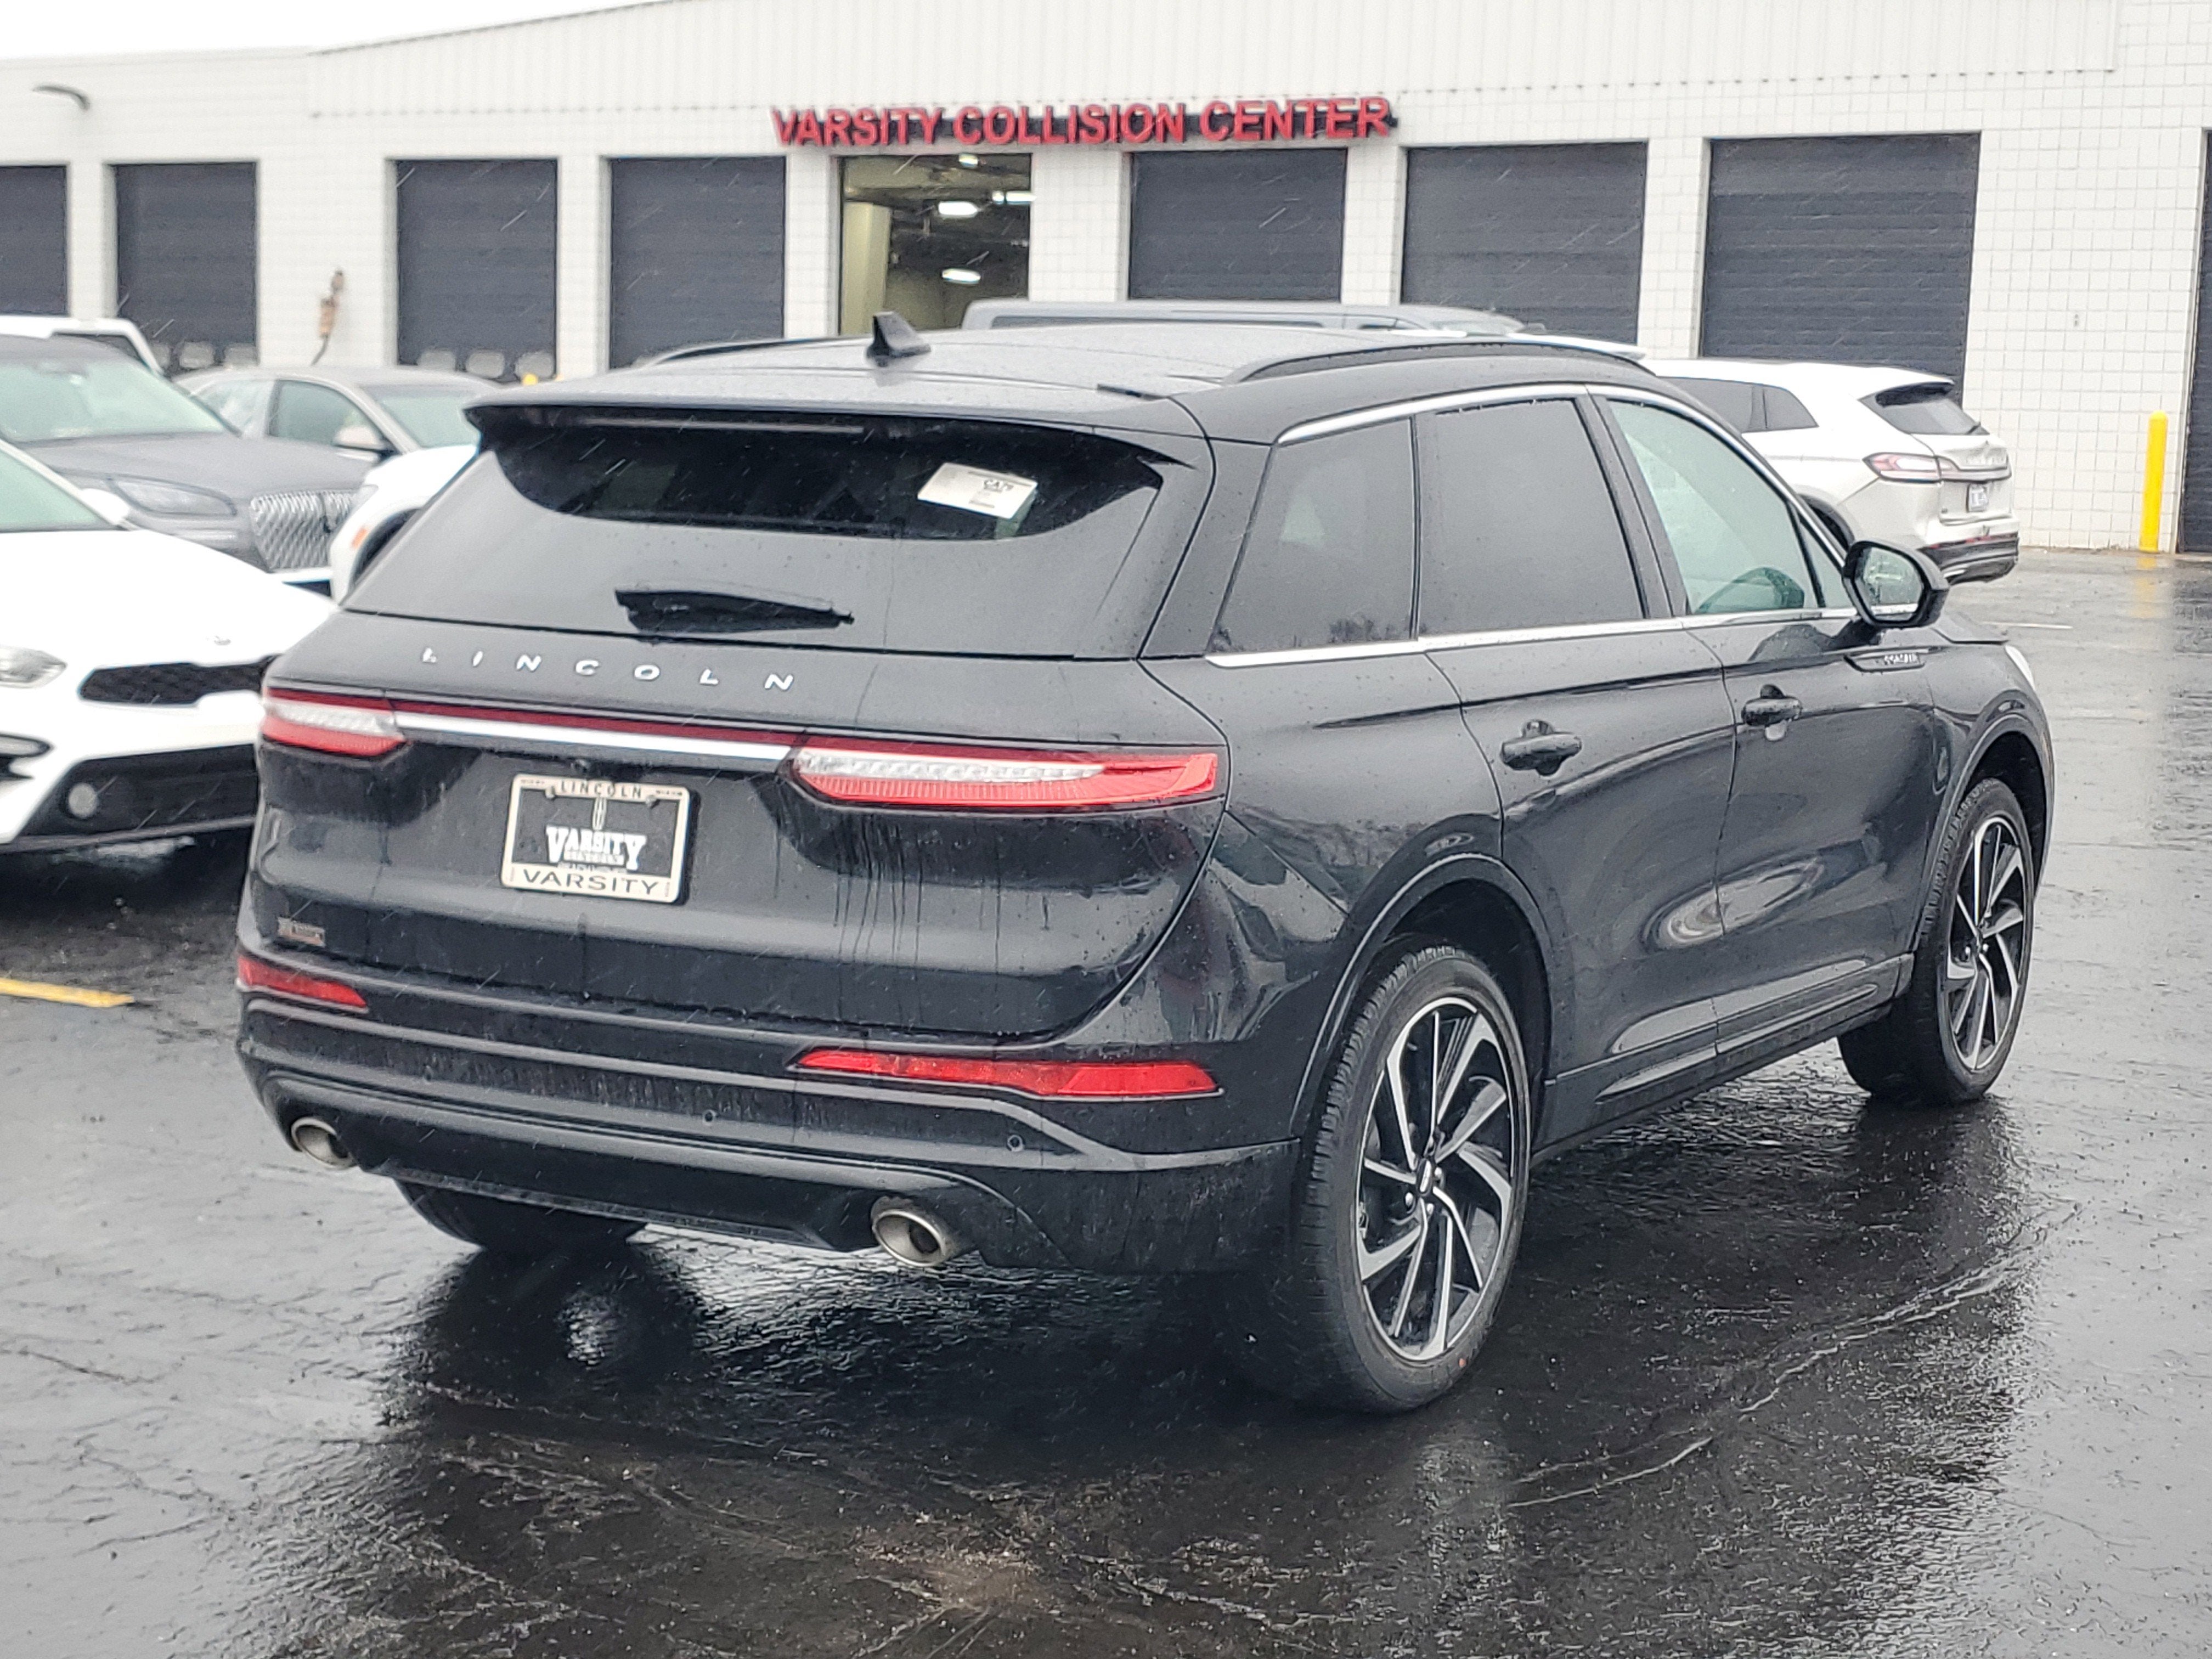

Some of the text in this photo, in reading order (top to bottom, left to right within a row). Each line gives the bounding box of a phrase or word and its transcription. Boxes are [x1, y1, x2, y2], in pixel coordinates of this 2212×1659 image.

[772, 97, 1392, 146] VARSITY COLLISION CENTER
[422, 648, 794, 691] LINCOLN
[561, 780, 642, 798] LINCOLN
[545, 825, 647, 871] VARSITY
[523, 868, 659, 895] VARSITY
